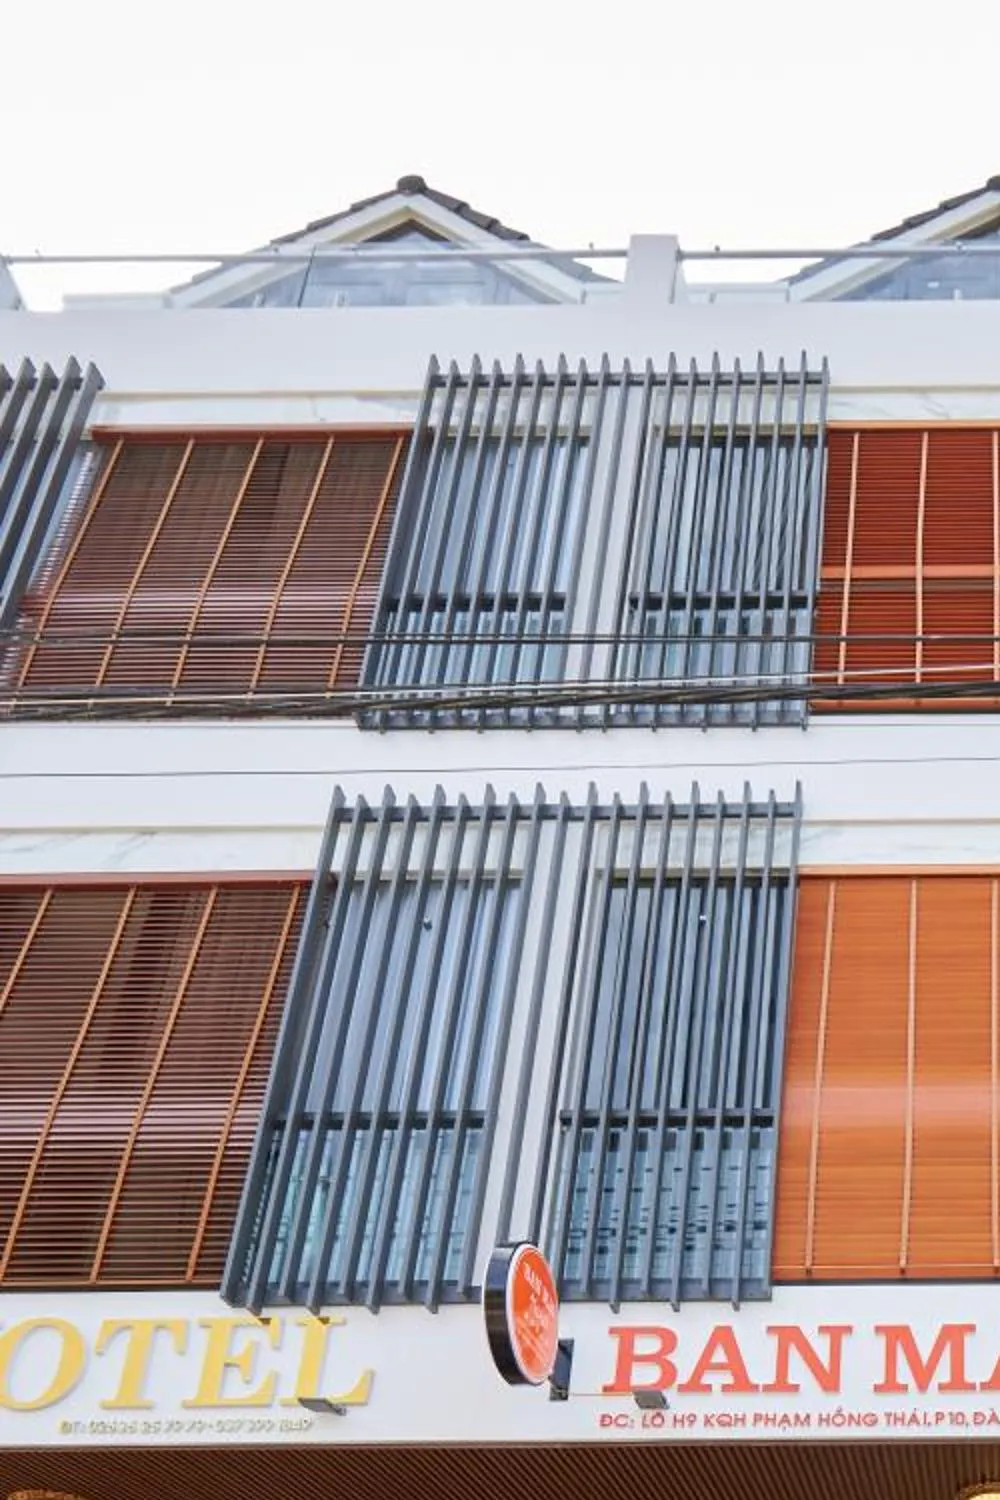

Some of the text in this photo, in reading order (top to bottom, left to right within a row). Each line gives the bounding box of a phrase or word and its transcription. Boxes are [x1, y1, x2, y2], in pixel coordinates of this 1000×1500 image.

[0, 1315, 376, 1411] OTEL
[602, 1324, 855, 1395] BAN
[599, 1413, 634, 1428] ĐC:
[672, 1413, 697, 1428] H9
[703, 1413, 746, 1427] KQH
[752, 1412, 811, 1431] PHẠM
